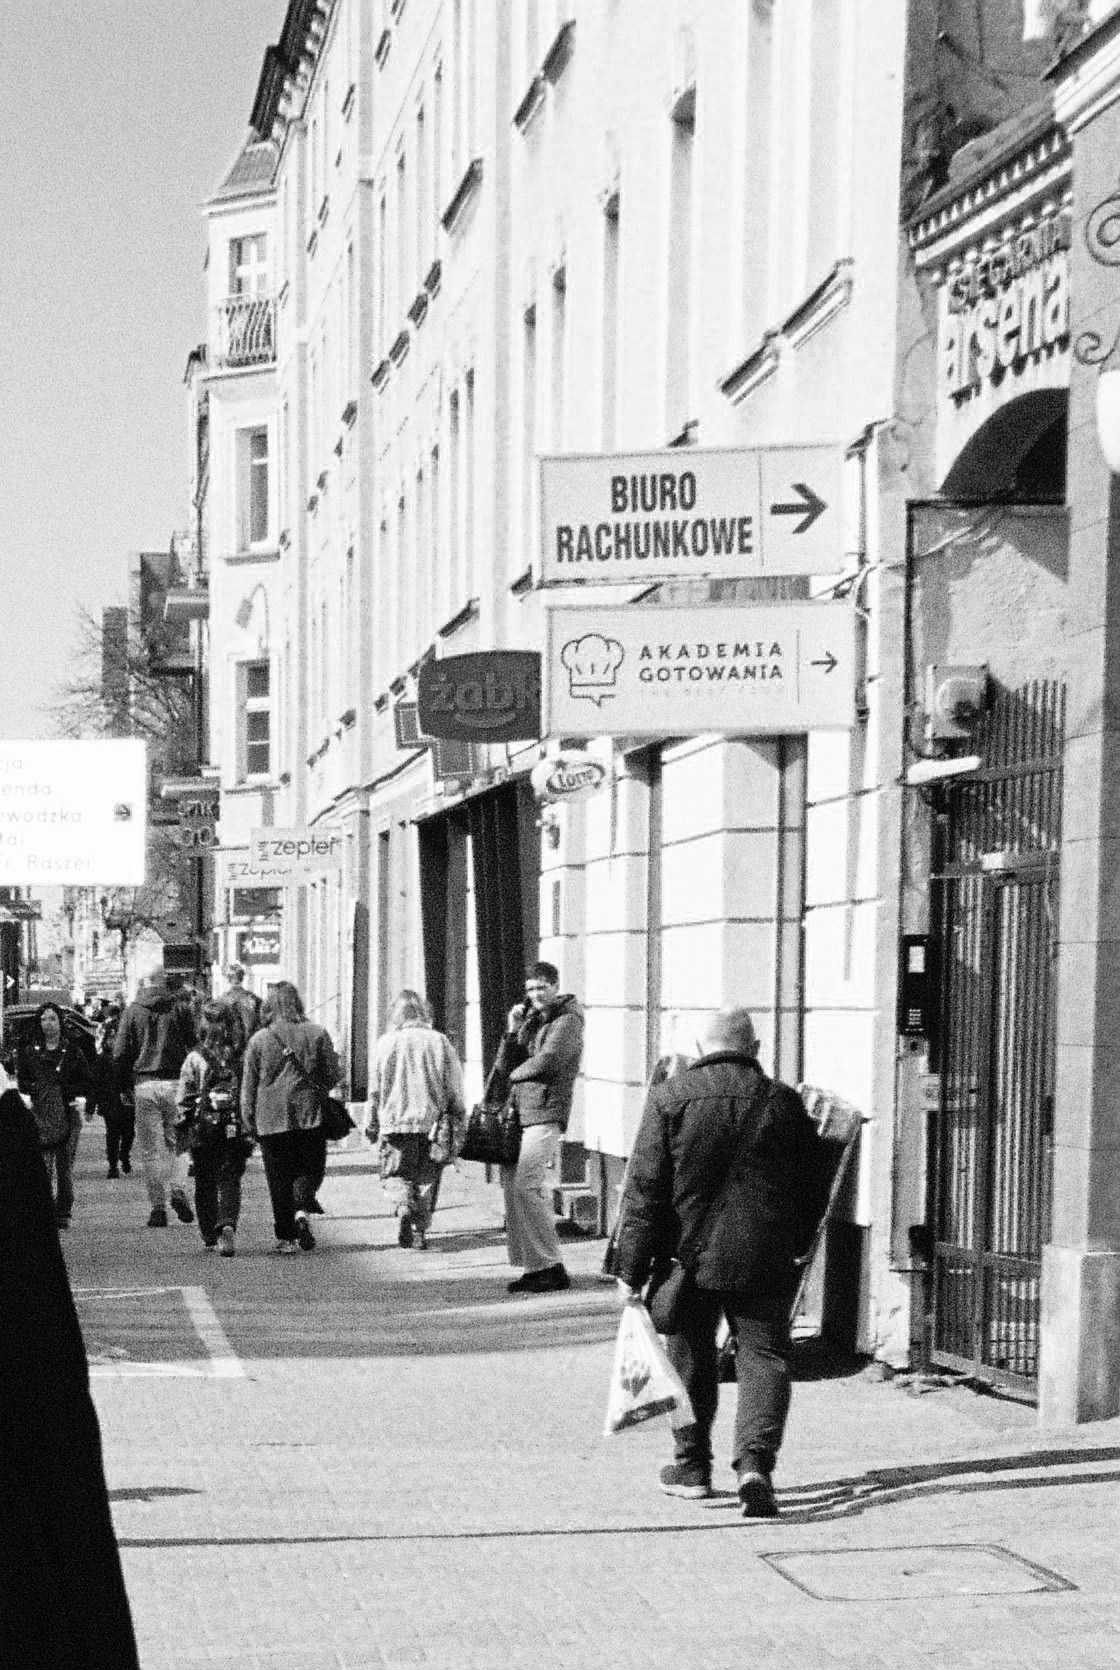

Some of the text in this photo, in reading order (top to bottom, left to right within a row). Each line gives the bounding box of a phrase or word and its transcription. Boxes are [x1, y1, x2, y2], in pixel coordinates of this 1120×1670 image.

[611, 471, 696, 514] BIURO
[556, 516, 753, 563] RACHUNKOWE
[639, 642, 783, 660] AKADEMIA
[639, 664, 783, 683] GOTOWANIA
[429, 672, 540, 712] żabk
[271, 835, 337, 861] zepter
